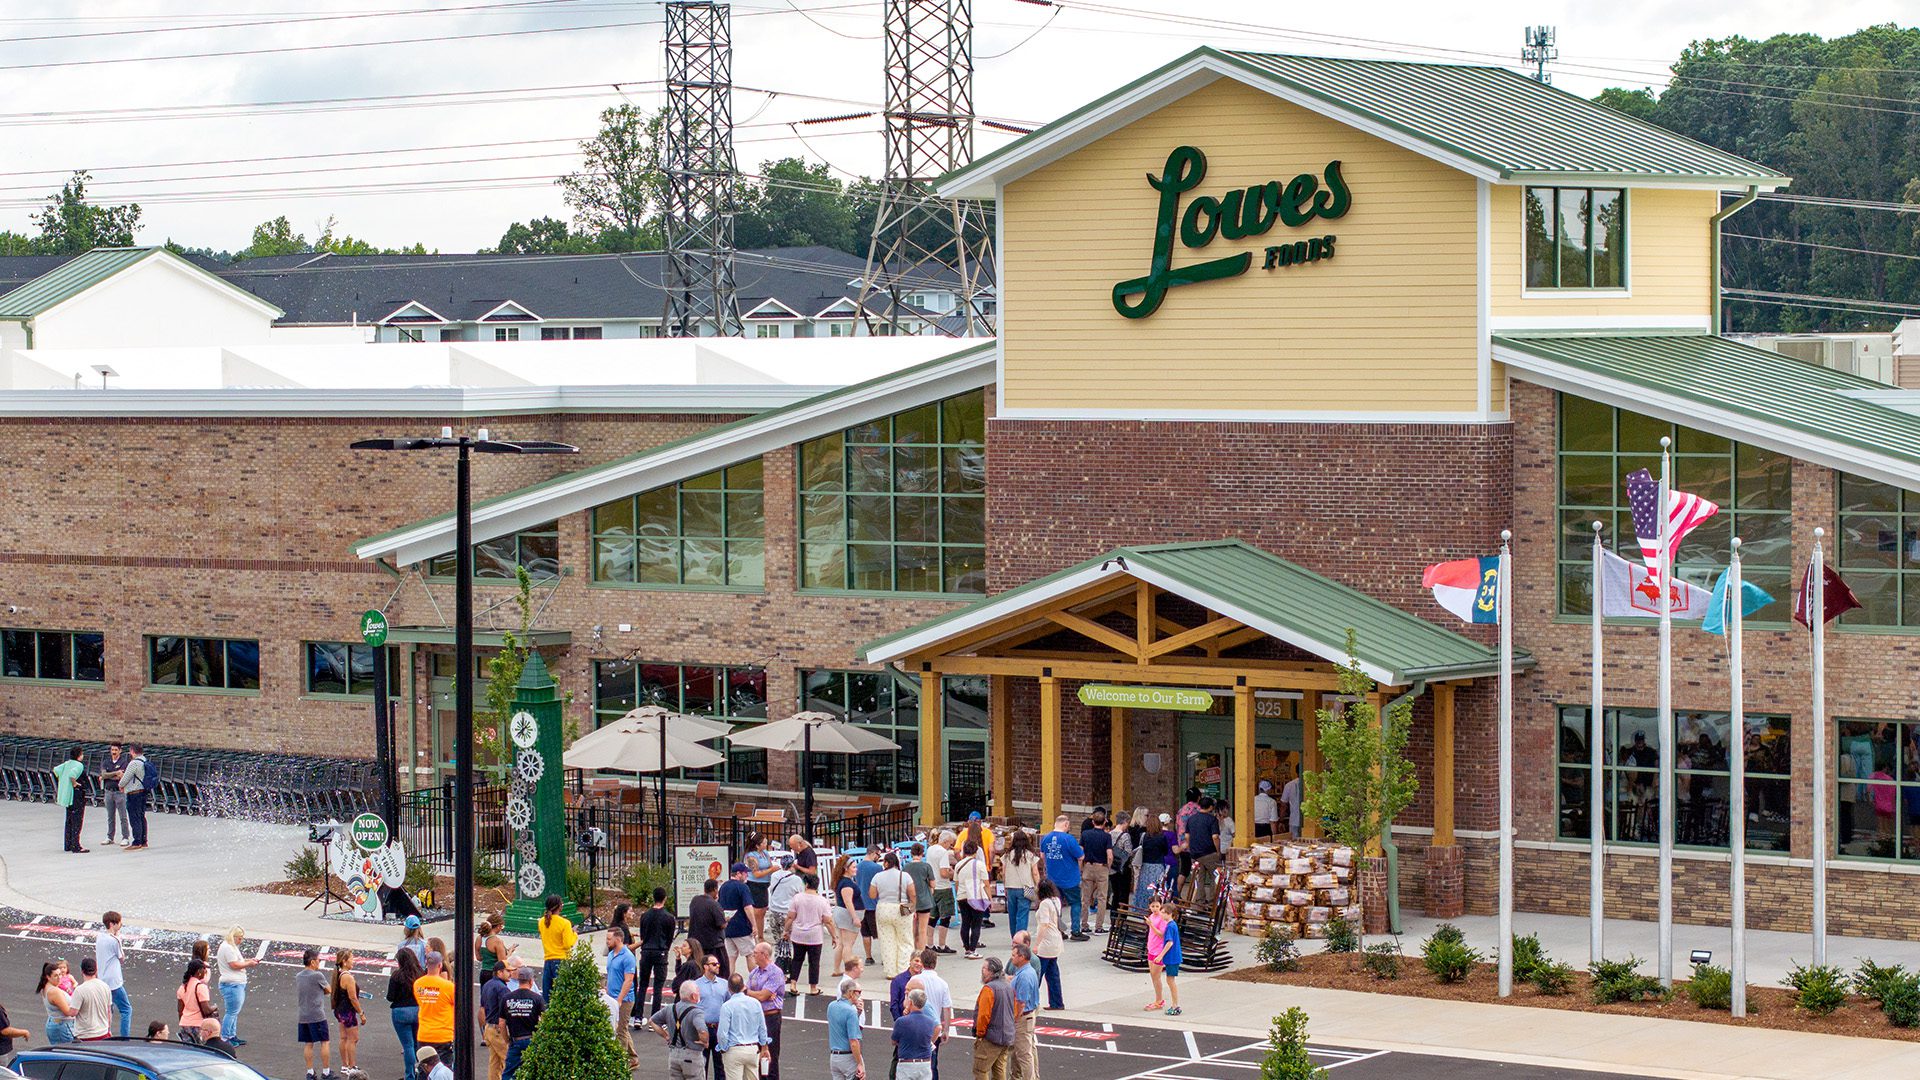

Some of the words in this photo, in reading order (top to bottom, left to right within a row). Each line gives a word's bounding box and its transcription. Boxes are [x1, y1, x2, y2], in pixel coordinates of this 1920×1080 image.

[1112, 145, 1352, 319] Lowes
[1262, 235, 1336, 270] FOODS
[363, 618, 385, 636] Lowes
[1085, 688, 1136, 702] Welcome
[1138, 692, 1150, 703] to
[1152, 691, 1174, 705] Our
[1176, 693, 1205, 706] Farm
[1254, 701, 1282, 716] 925
[358, 819, 380, 829] NOW
[355, 831, 384, 841] OPEN!
[384, 845, 401, 878] atching
